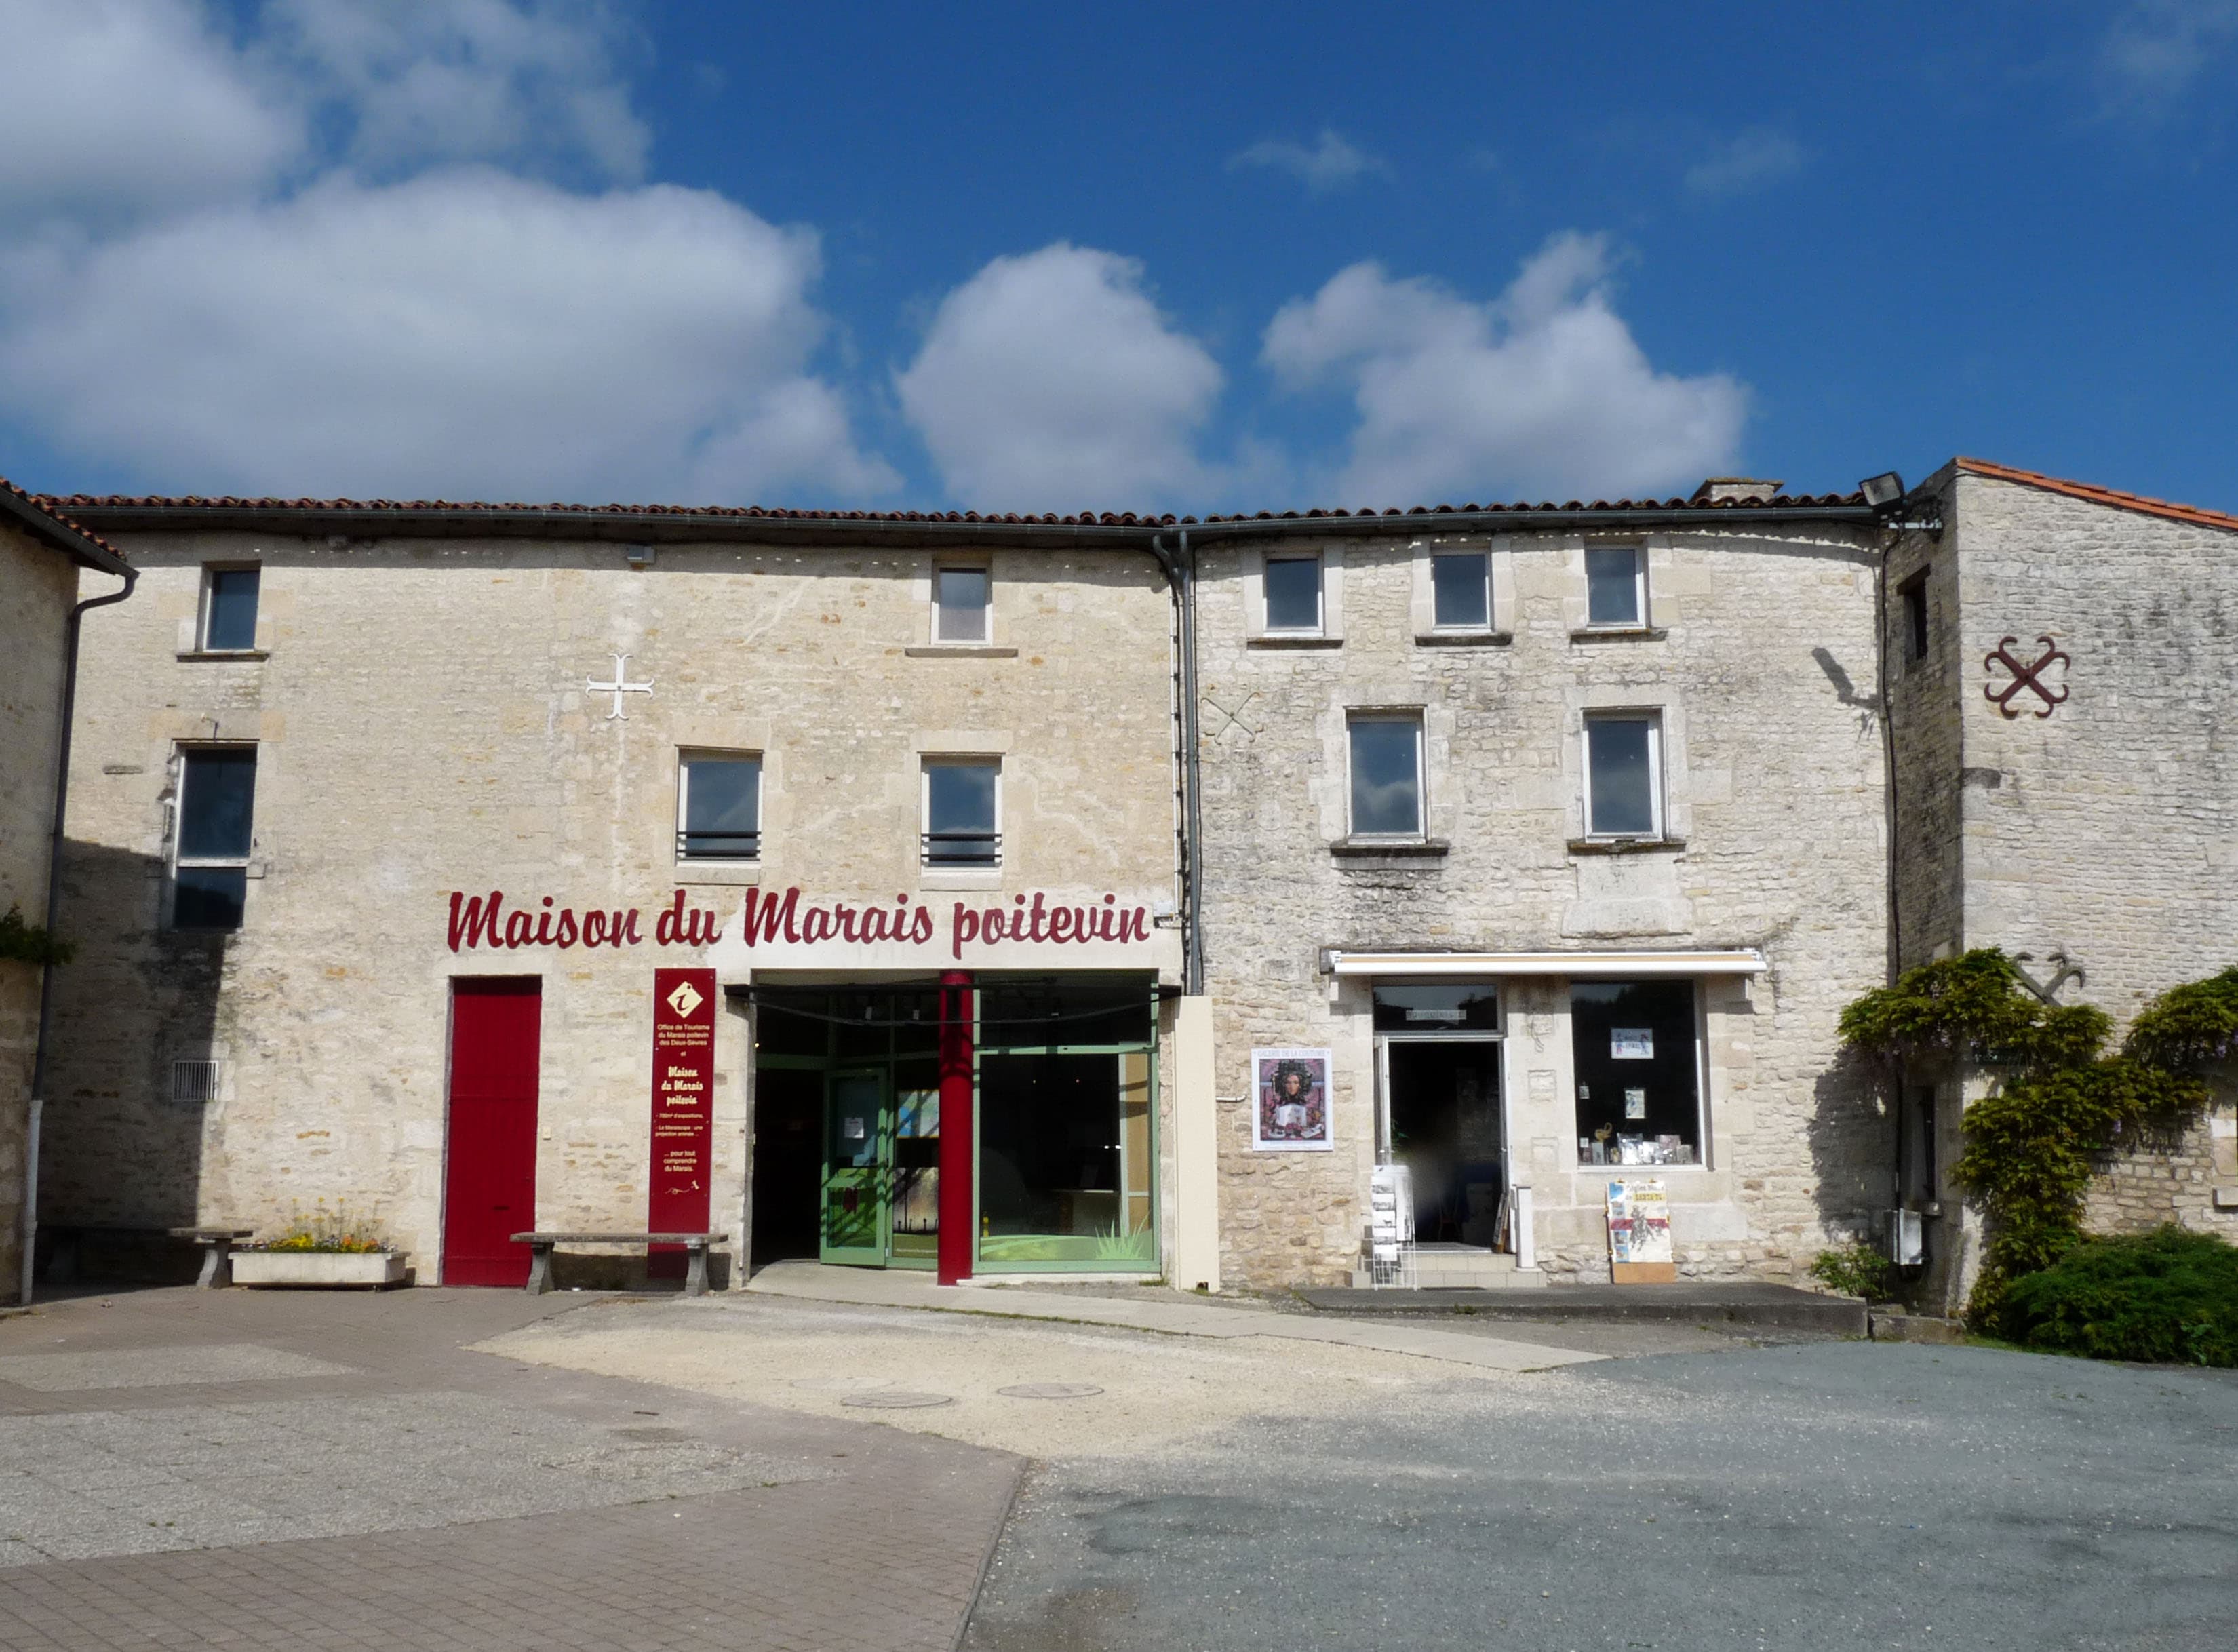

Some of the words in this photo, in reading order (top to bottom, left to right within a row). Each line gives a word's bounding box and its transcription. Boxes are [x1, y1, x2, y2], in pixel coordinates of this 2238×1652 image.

[447, 890, 639, 951] Maison
[656, 888, 722, 946] du
[743, 887, 933, 947] Marais
[952, 892, 1150, 960] poitevin
[668, 1066, 698, 1077] Maison
[661, 1080, 672, 1090] du
[674, 1080, 703, 1090] Marais
[667, 1095, 697, 1107] poitevin
